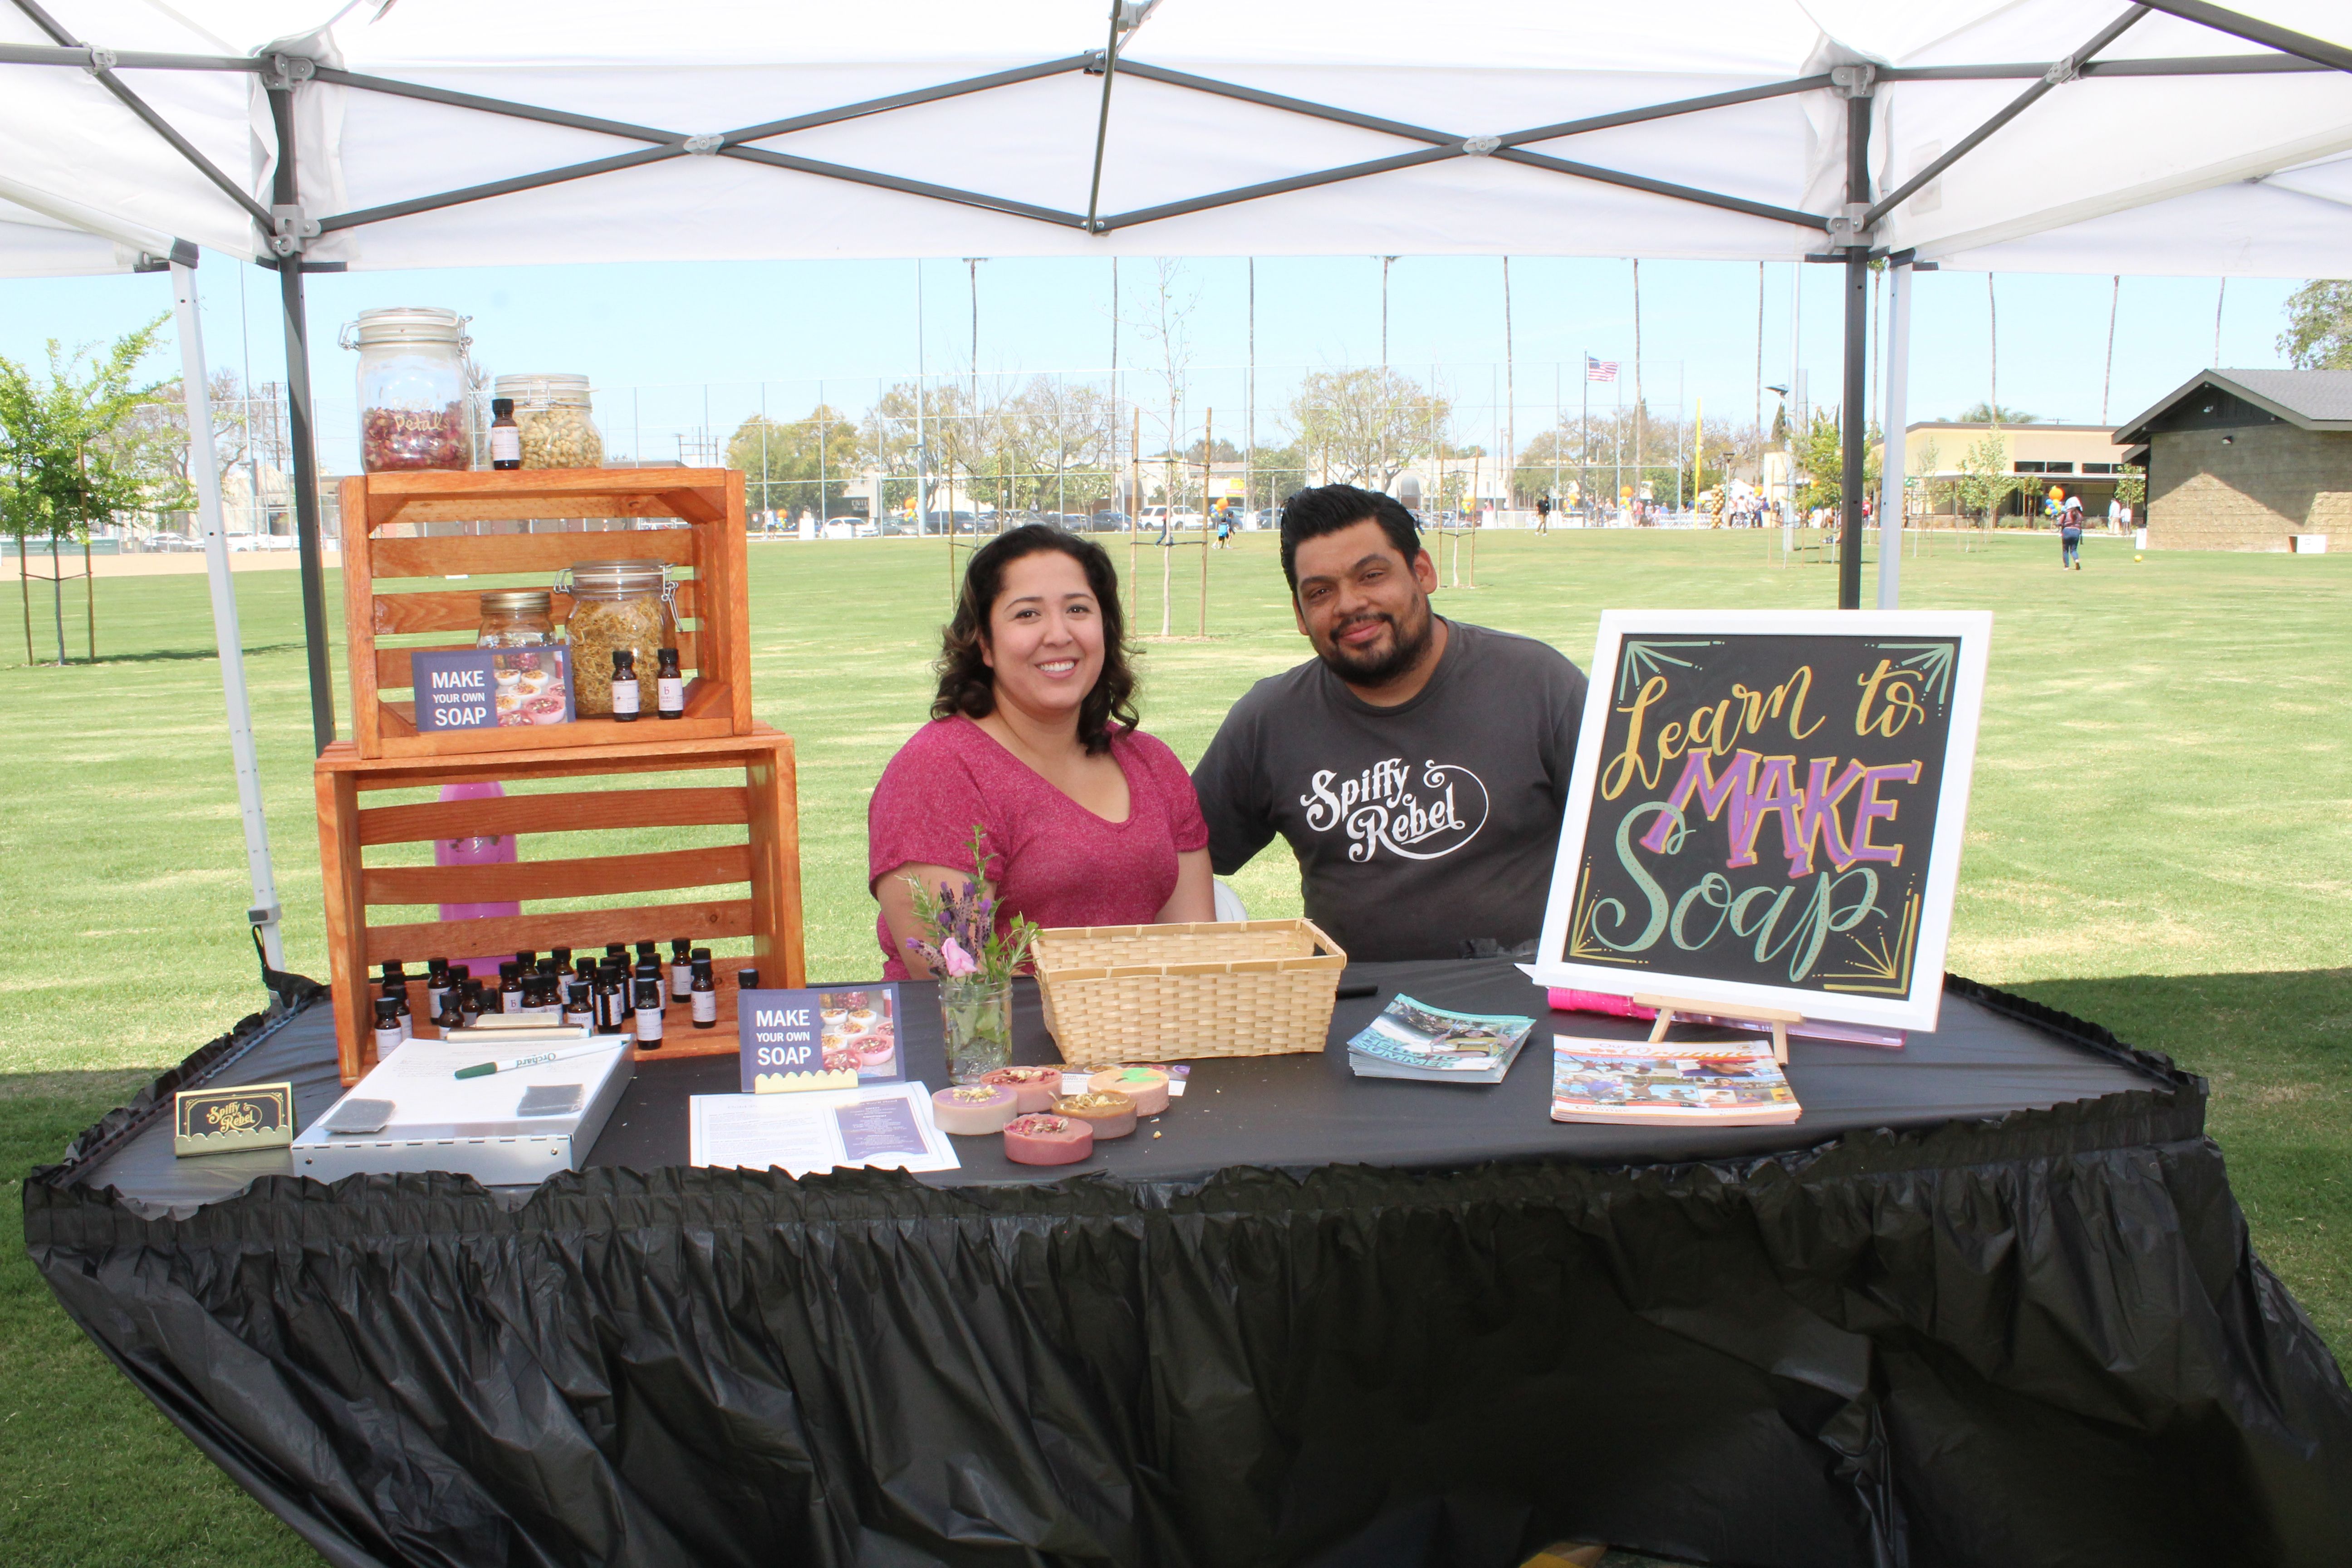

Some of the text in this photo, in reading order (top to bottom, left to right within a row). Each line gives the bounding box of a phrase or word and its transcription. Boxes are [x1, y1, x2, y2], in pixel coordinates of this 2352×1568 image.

[392, 396, 432, 411] Rose
[395, 409, 450, 431] Petals
[432, 670, 485, 688] MAKE
[432, 692, 485, 704] YOUR OWN
[435, 707, 487, 726] SOAP
[1602, 659, 1924, 800] Learn to
[1300, 758, 1411, 832] Spiffy
[1346, 779, 1489, 862] Rebel
[1639, 747, 1922, 879] MAKE
[1591, 801, 1888, 982] Soap
[756, 1009, 811, 1027] MAKE
[756, 1031, 810, 1043] YOUR OWN
[1368, 1029, 1410, 1046] SAY
[757, 1046, 812, 1066] SOAP
[1354, 1039, 1455, 1068] SUMMER
[1362, 1034, 1461, 1062] HELLO TO
[1622, 1047, 1754, 1060] Orange
[515, 1052, 557, 1068] Orchard
[206, 1101, 240, 1124] Spiffy
[220, 1109, 263, 1133] Rebel
